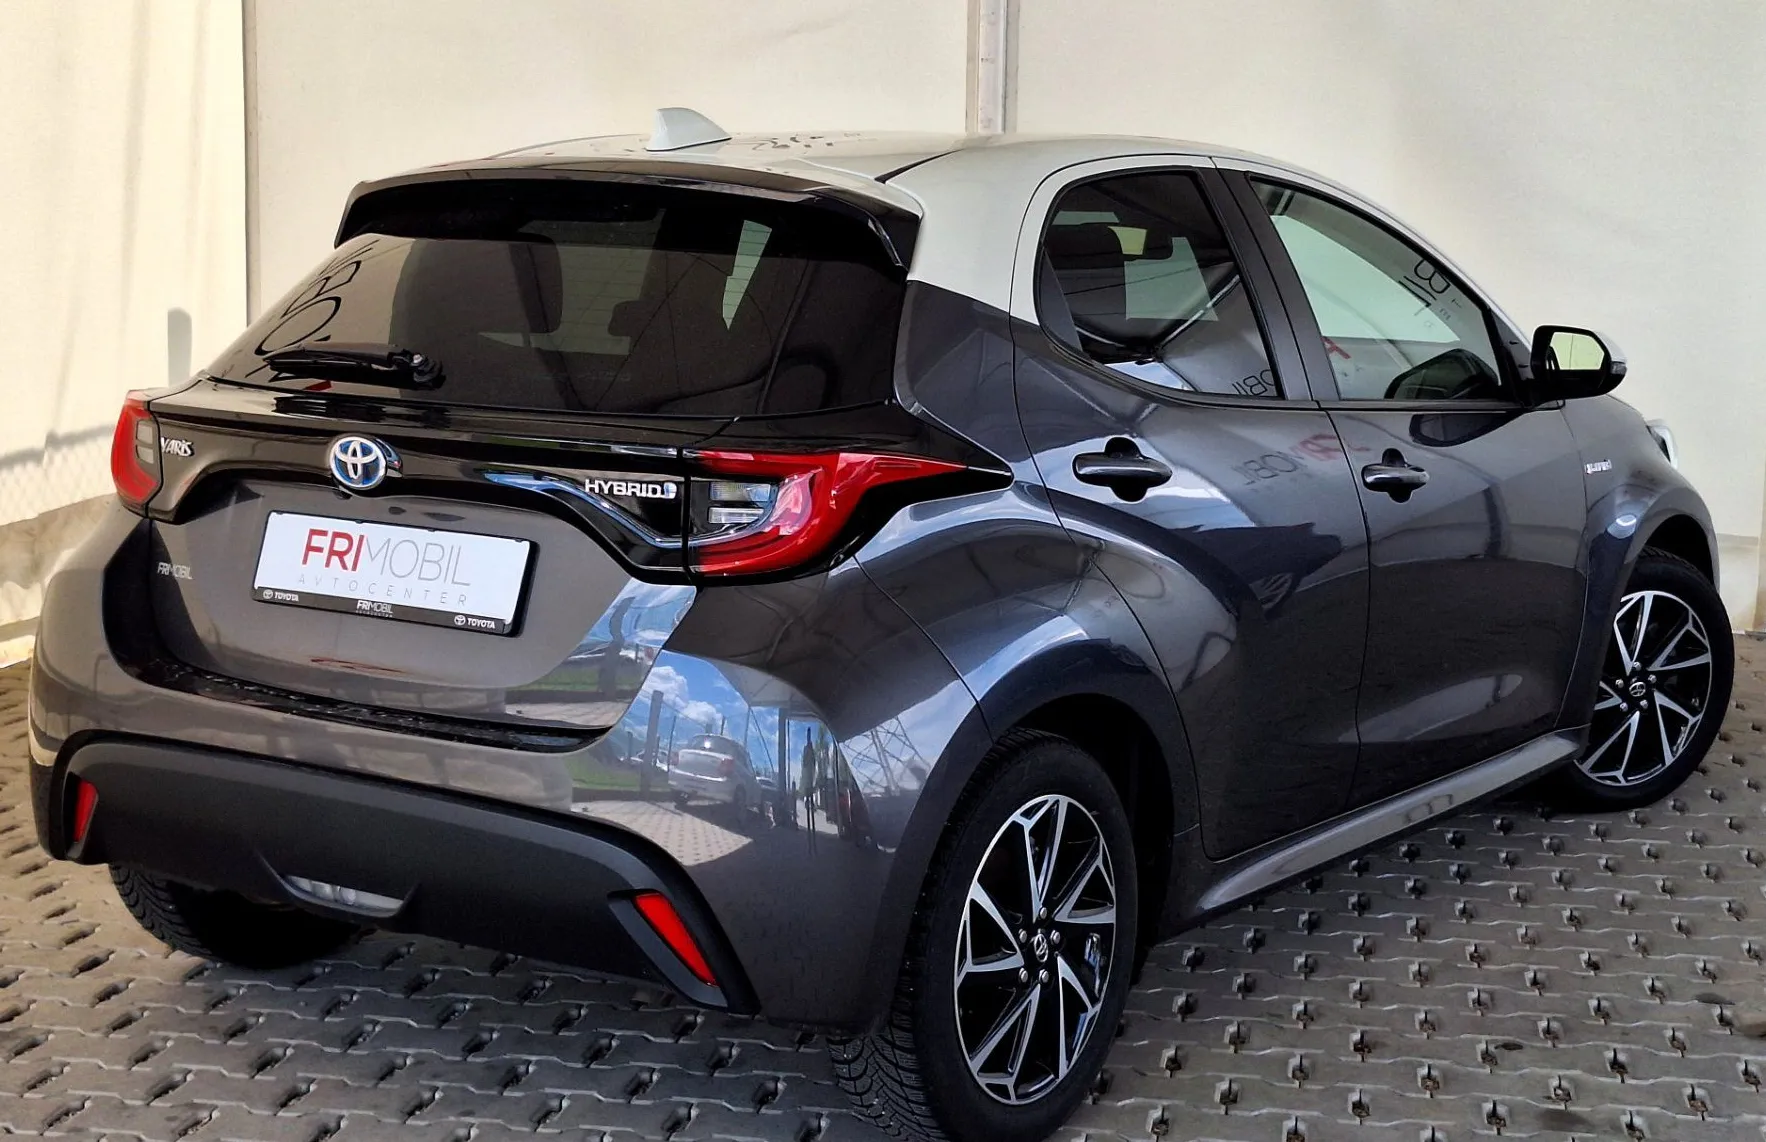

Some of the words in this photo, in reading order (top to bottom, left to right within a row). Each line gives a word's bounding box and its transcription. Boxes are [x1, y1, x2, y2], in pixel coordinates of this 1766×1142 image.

[160, 437, 193, 457] YARIS
[584, 478, 661, 499] HYBRID
[302, 528, 470, 587] FRIMOBIL
[157, 562, 193, 581] FRIMOBIL
[274, 591, 299, 603] TOYOTA
[298, 573, 468, 607] AVTOCENTER
[356, 599, 393, 614] FRIMOBIL
[467, 617, 496, 630] TOYOTA
